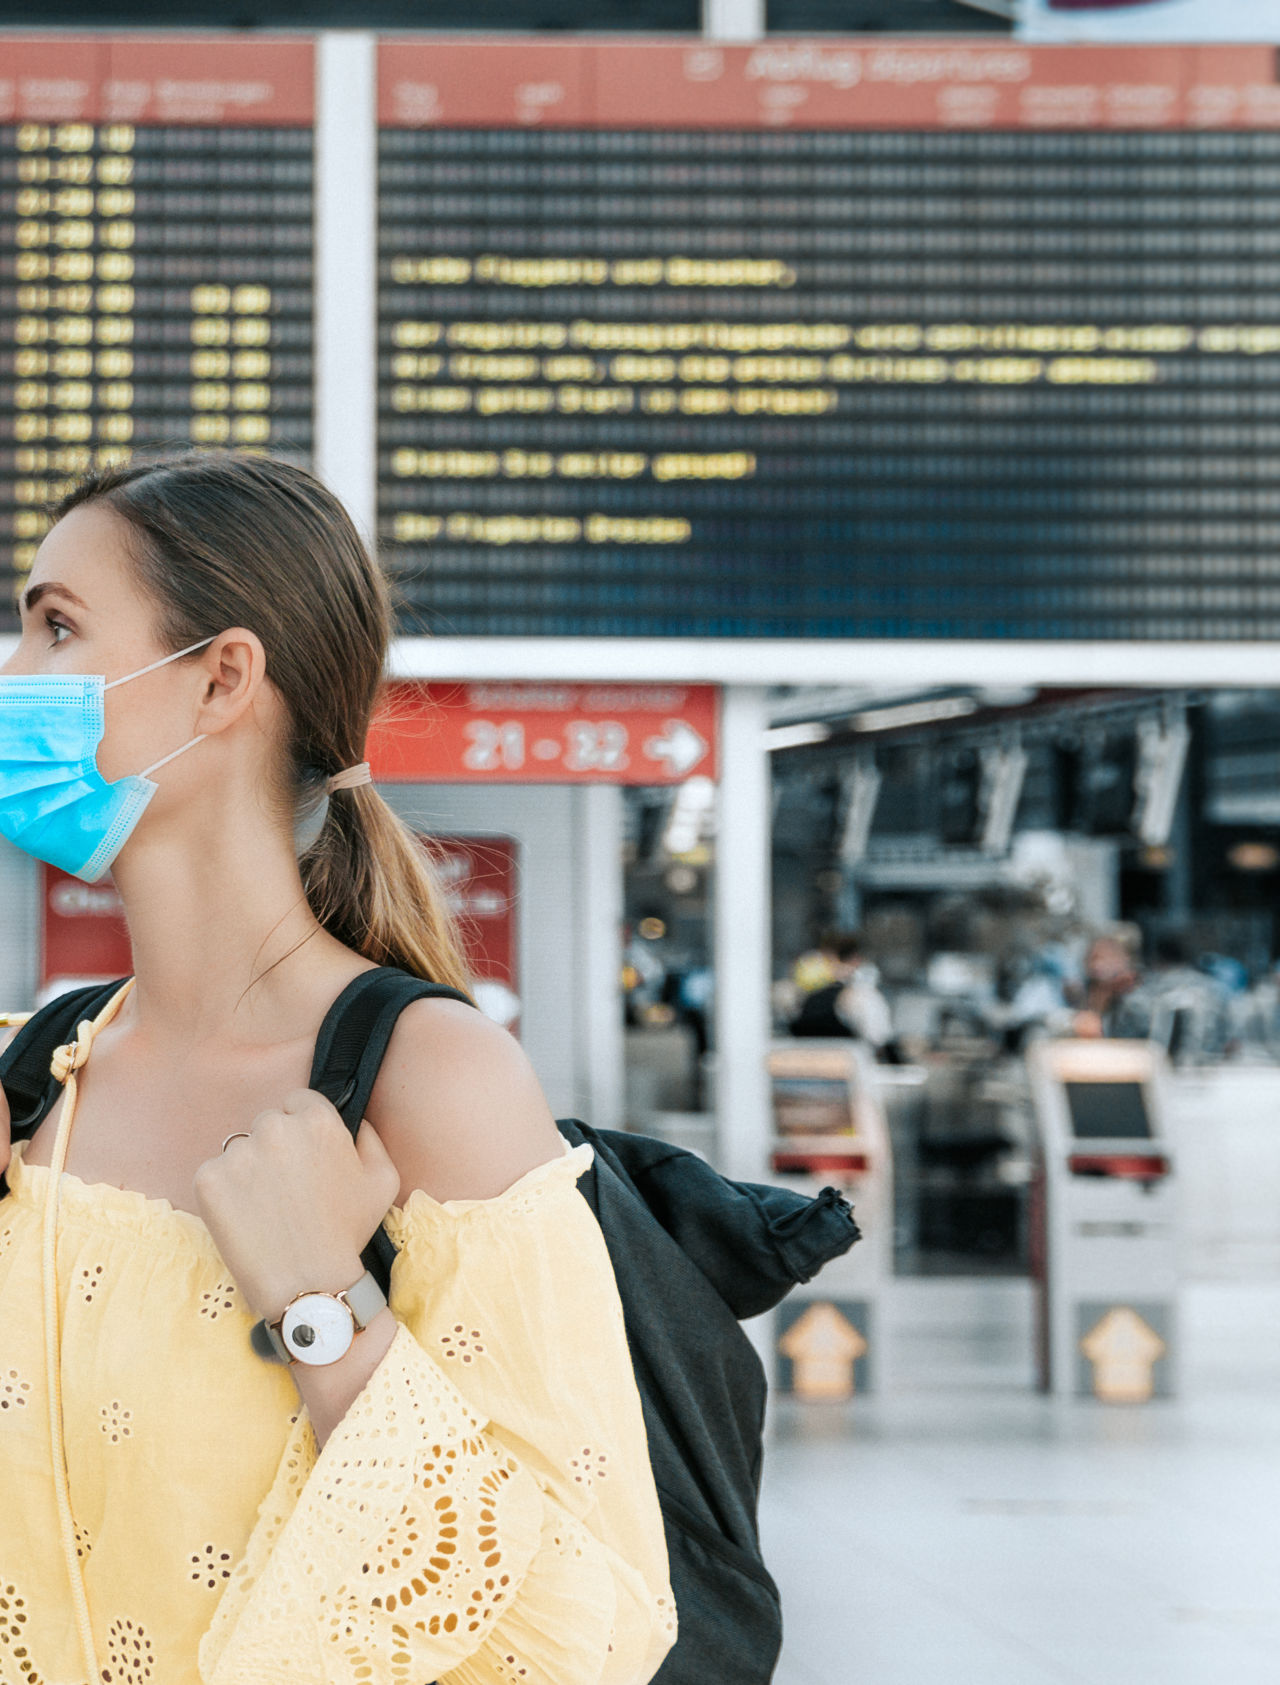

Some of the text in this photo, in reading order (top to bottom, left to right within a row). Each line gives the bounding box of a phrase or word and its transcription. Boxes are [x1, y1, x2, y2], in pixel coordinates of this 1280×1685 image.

[745, 44, 862, 88] Abflug
[461, 719, 525, 771] 21
[562, 719, 631, 772] 32
